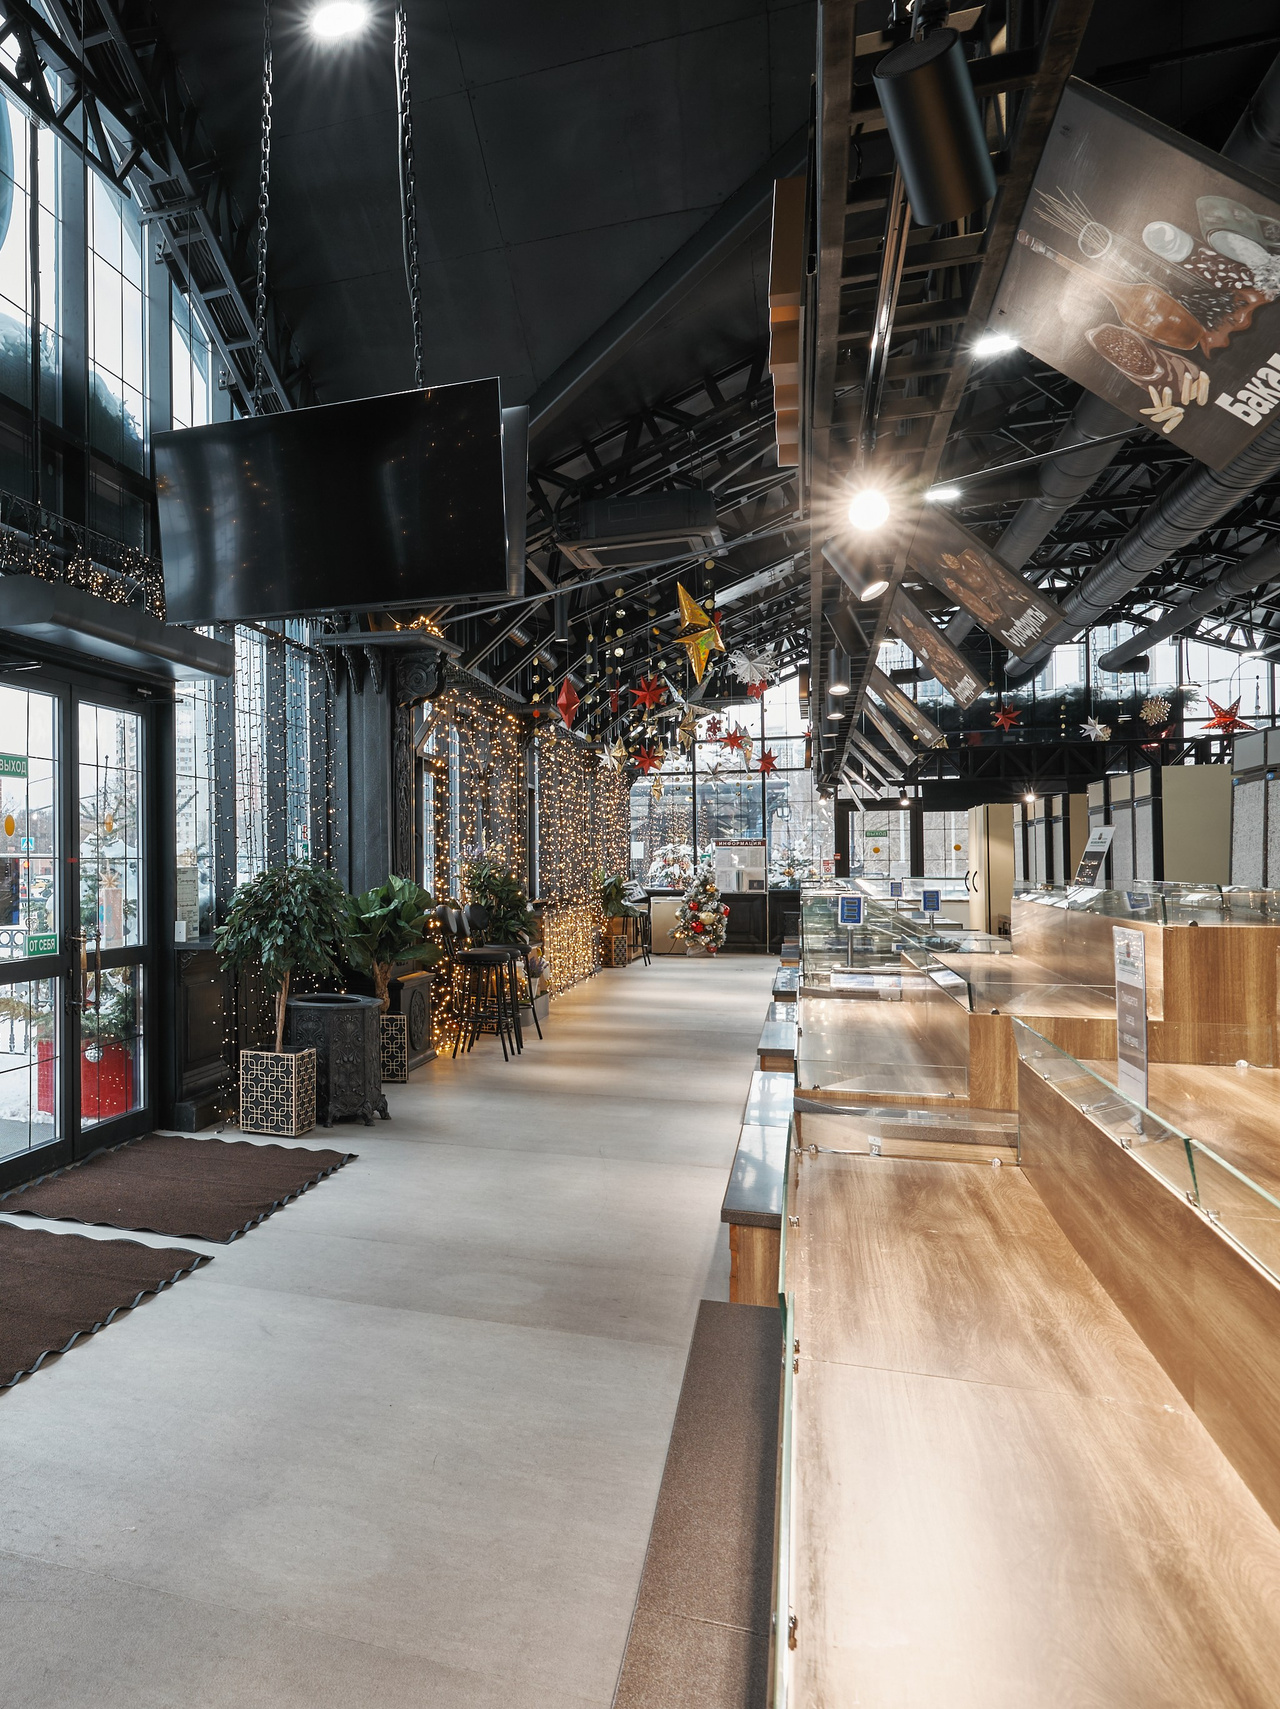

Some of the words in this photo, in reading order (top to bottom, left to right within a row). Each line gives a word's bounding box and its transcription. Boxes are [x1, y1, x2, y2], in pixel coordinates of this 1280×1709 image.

[1214, 352, 1280, 427] Бака
[1000, 604, 1048, 648] Сухофрукты
[29, 939, 38, 951] ОТ
[39, 937, 56, 951] СЕБЯ
[872, 1145, 879, 1154] 22
